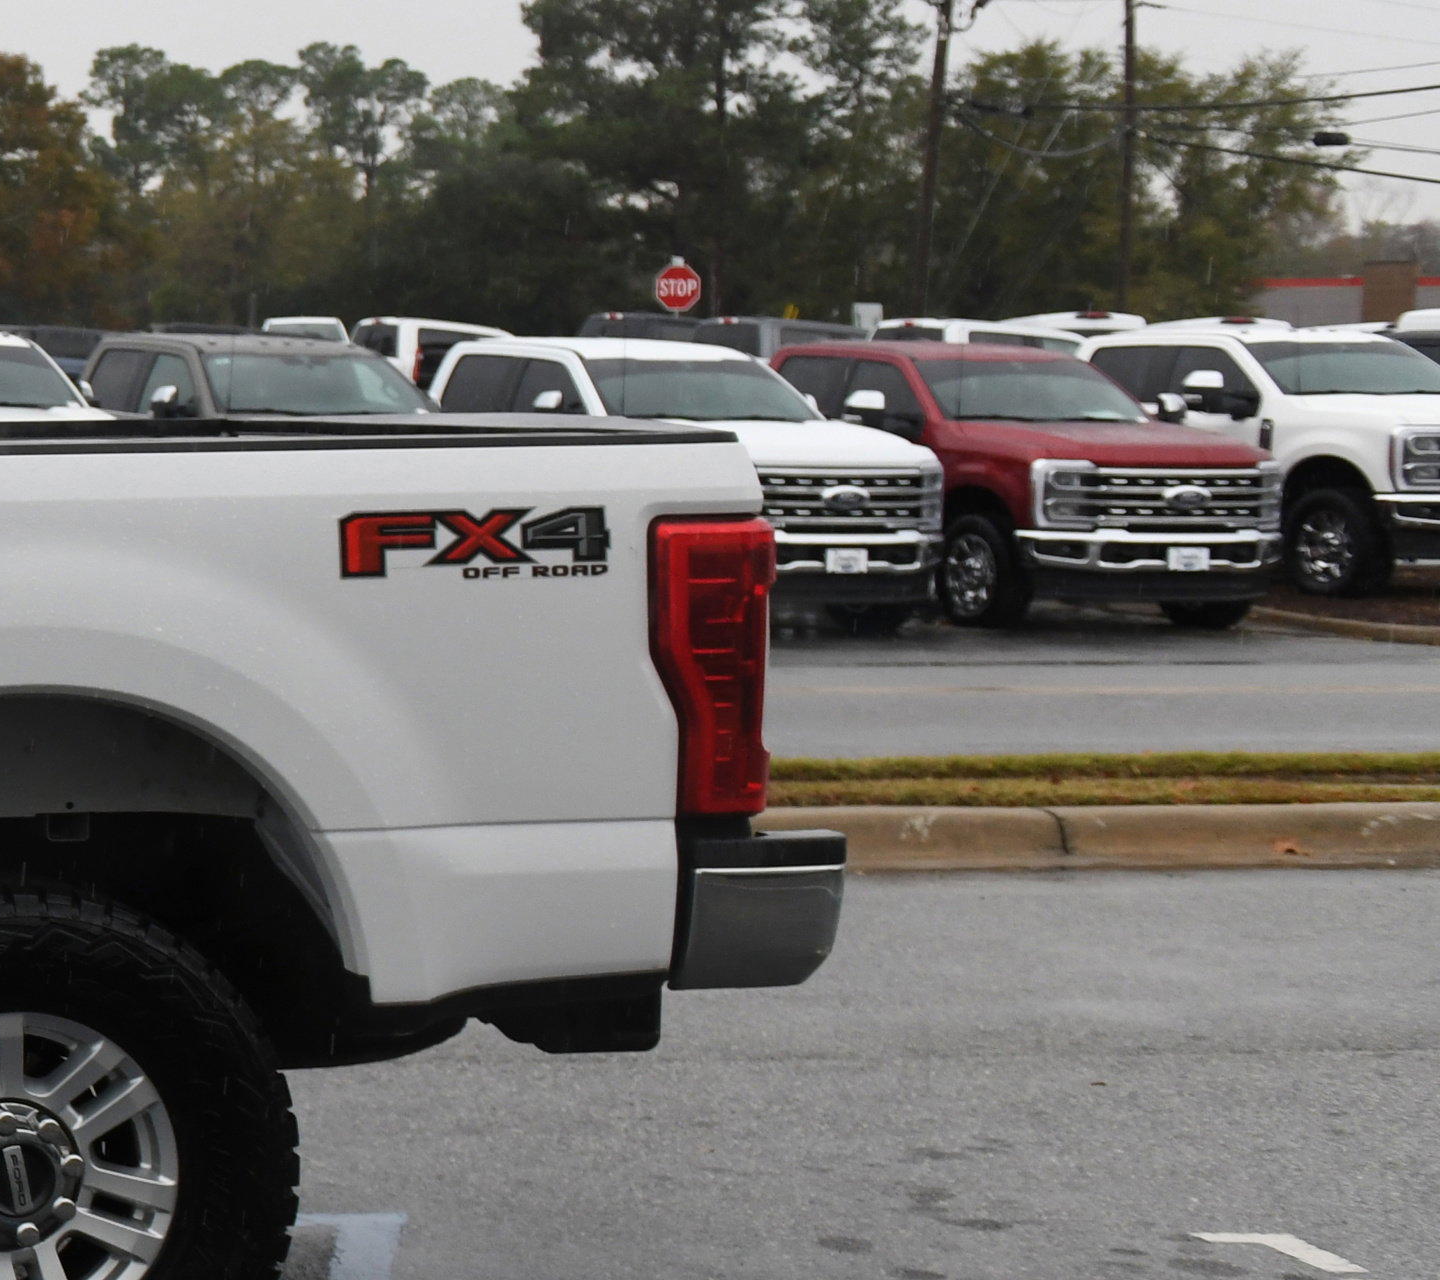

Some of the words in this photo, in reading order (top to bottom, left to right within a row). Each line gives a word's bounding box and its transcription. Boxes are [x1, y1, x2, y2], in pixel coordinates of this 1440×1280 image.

[660, 278, 697, 297] STOP
[340, 506, 610, 579] FX4
[462, 566, 520, 579] OFF
[532, 564, 609, 578] ROAD
[10, 1154, 26, 1207] FORD
